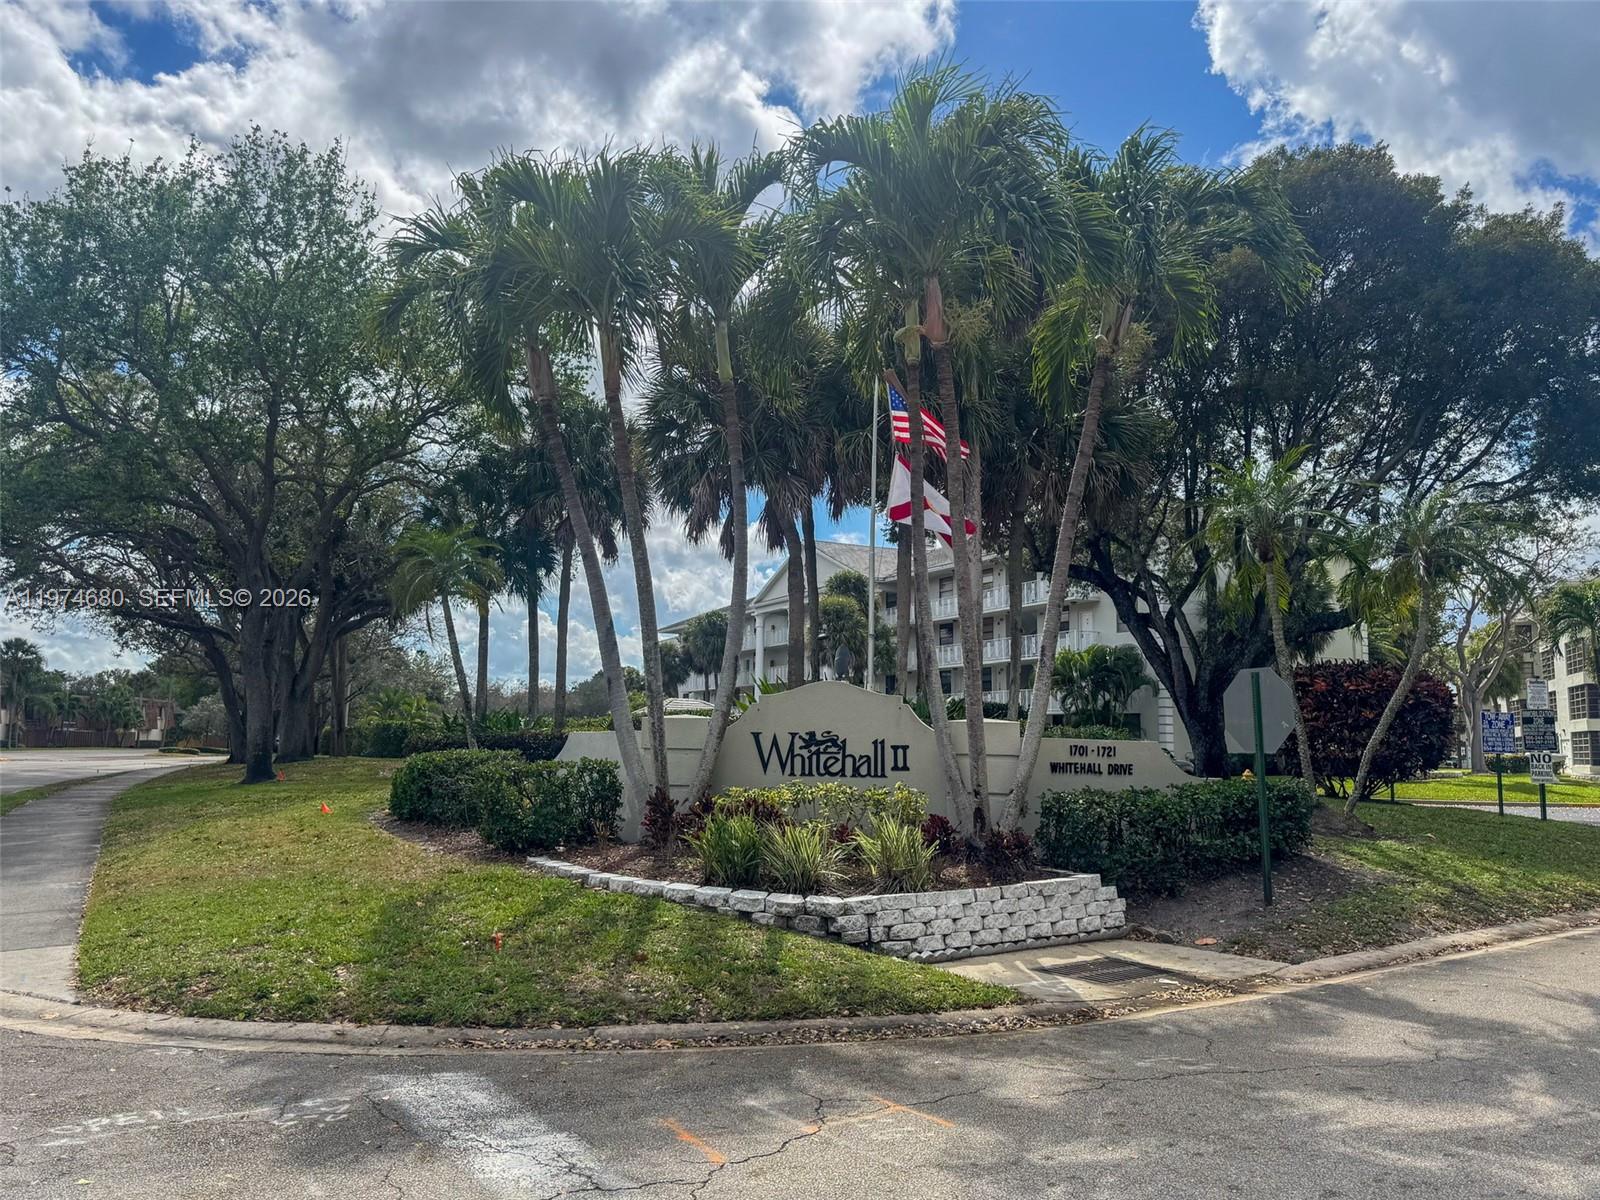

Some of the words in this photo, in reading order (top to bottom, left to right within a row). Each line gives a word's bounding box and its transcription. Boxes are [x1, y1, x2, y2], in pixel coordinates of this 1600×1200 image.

[1491, 721, 1506, 729] ZONE
[750, 731, 888, 778] Whitehall
[890, 744, 910, 771] II
[1069, 744, 1088, 757] 1701
[1097, 745, 1116, 758] 1721
[1531, 754, 1552, 763] NO
[1049, 761, 1103, 775] WHITEHALL
[1107, 763, 1134, 776] DRIVE
